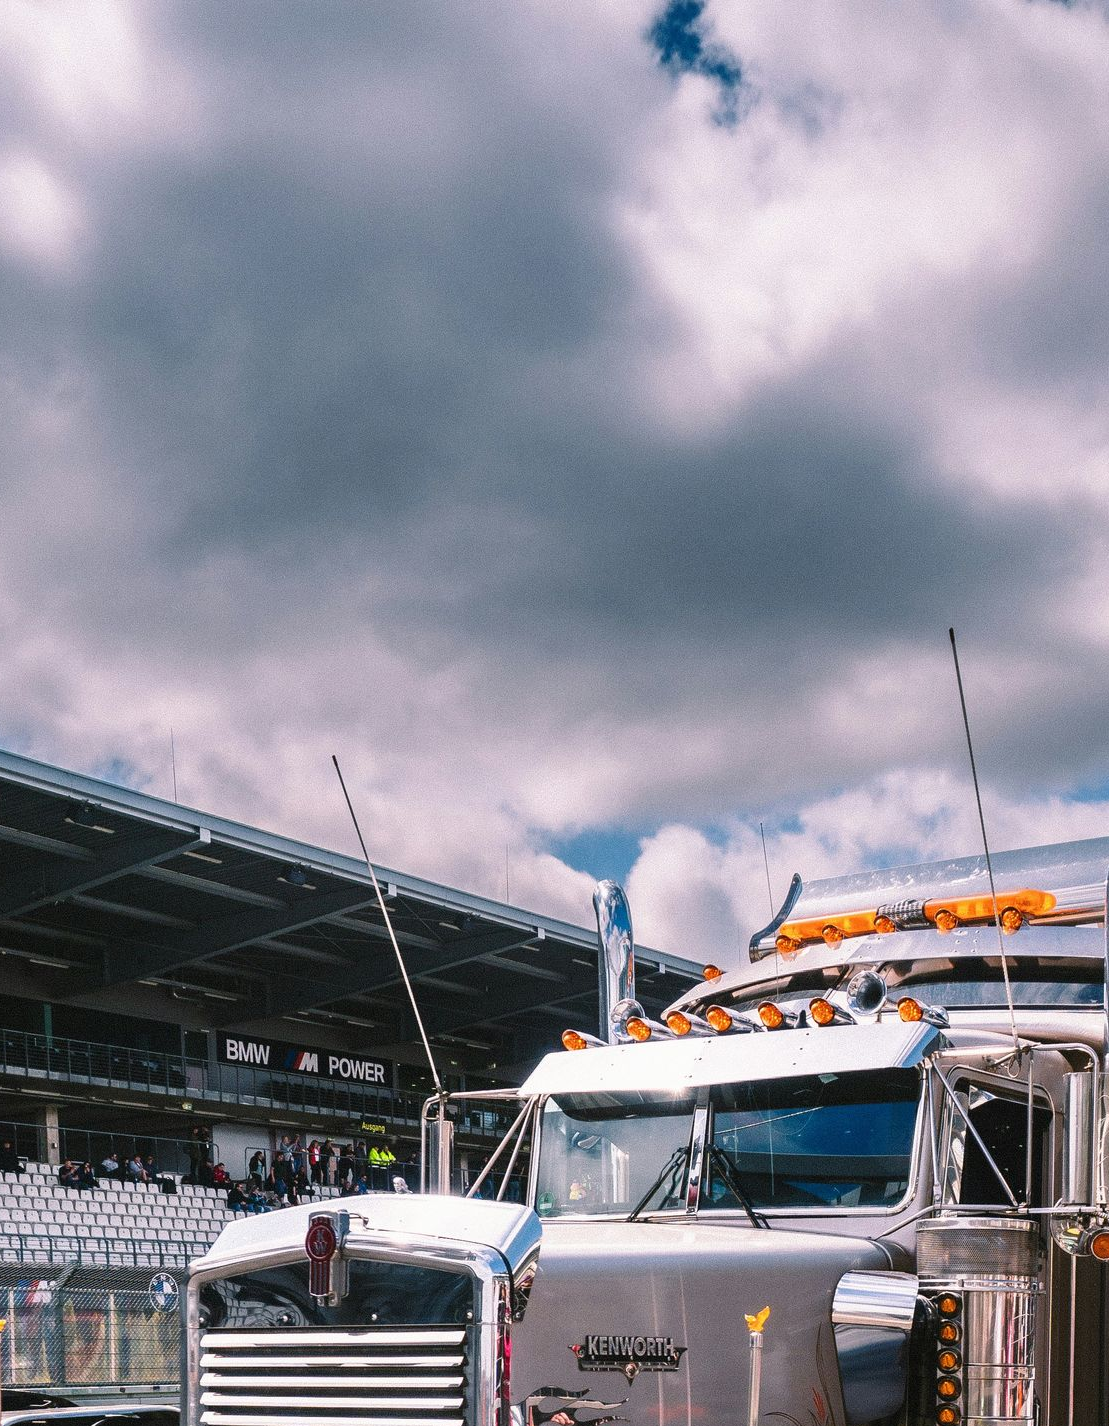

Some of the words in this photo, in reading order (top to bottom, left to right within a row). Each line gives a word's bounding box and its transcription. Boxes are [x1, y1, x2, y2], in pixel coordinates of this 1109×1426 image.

[226, 1038, 270, 1065] BMW
[328, 1056, 385, 1083] POWER
[361, 1121, 386, 1134] Ausgang
[587, 1335, 675, 1357] KENWORTH
